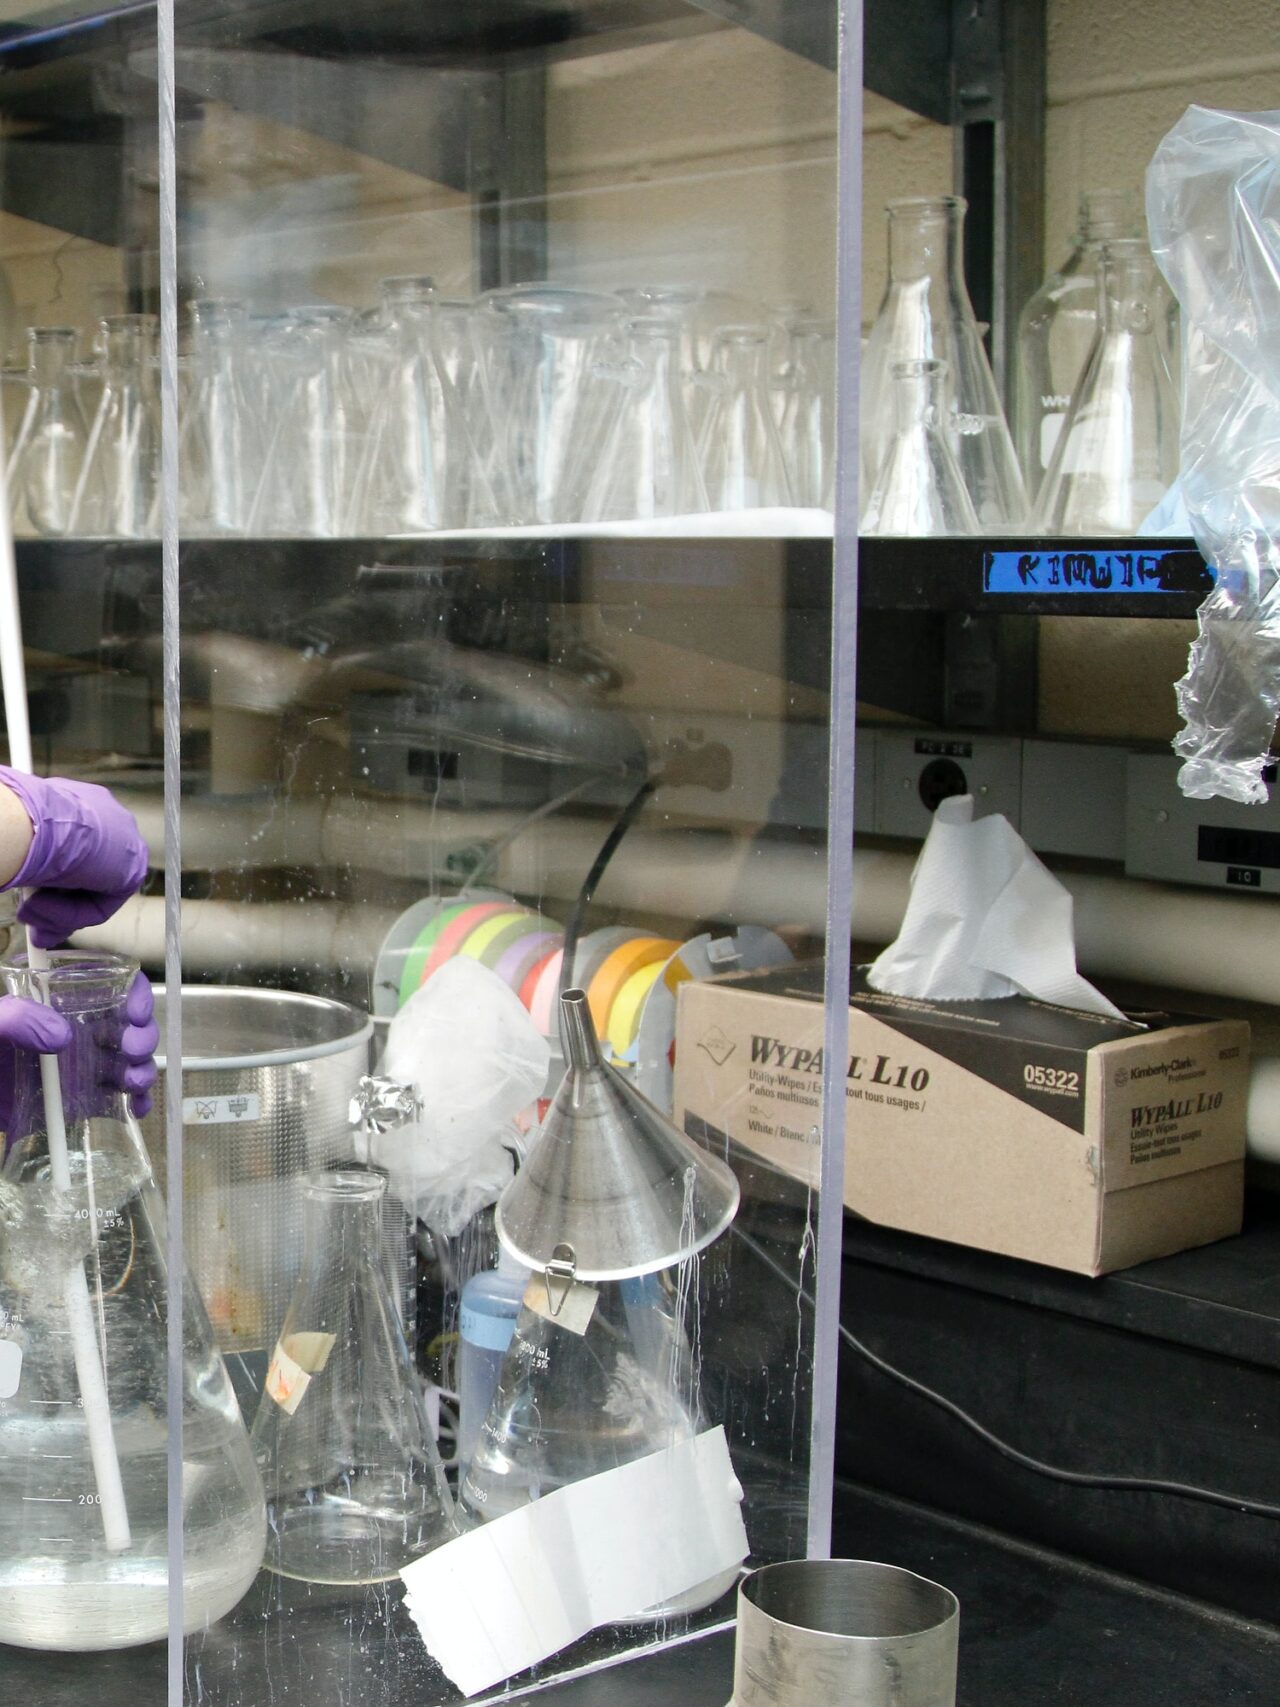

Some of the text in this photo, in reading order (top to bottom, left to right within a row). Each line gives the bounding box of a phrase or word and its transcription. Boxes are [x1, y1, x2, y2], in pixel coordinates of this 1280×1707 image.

[870, 1055, 930, 1092] L10
[1024, 1064, 1079, 1091] 05322
[749, 1069, 805, 1090] Utility-Wipes
[865, 1091, 884, 1103] tous
[886, 1096, 919, 1111] usages
[748, 1120, 773, 1135] White
[780, 1126, 805, 1142] Blanc
[103, 1217, 124, 1228] ±5%
[78, 1494, 103, 1505] 200
